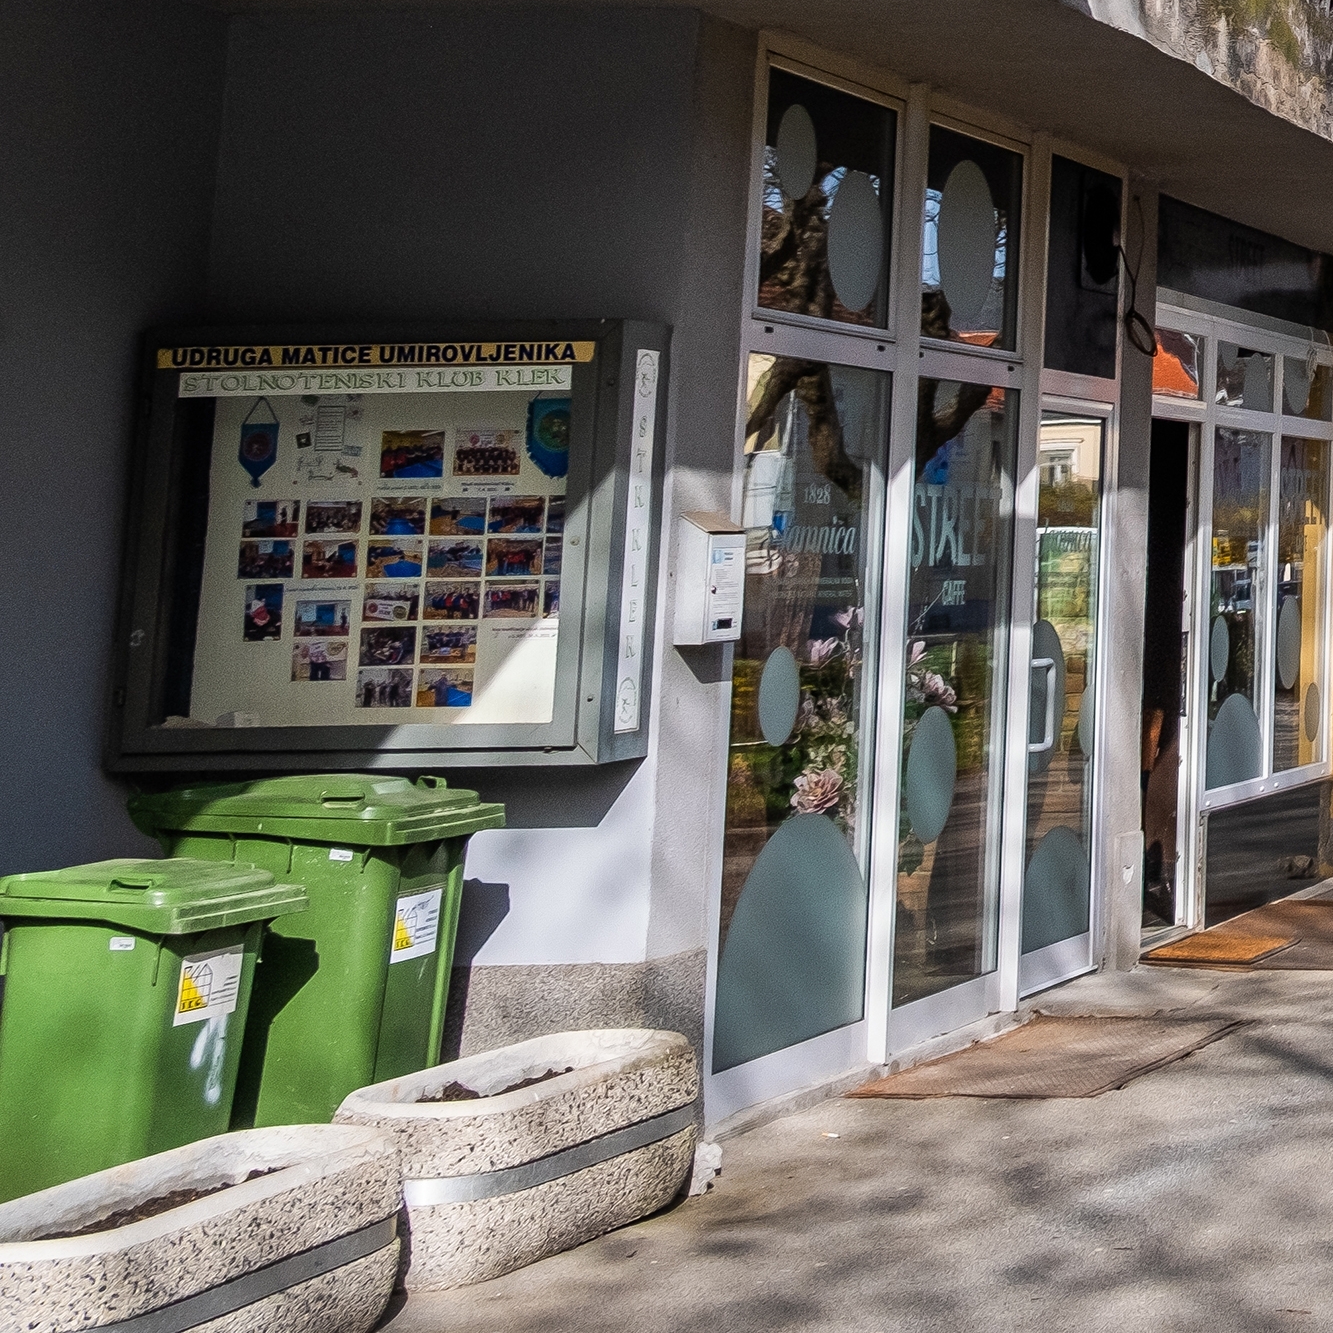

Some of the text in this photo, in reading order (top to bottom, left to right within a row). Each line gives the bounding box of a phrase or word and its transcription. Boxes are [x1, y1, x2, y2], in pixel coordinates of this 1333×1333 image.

[172, 343, 577, 367] UDRUGA MATICE UMIROVLJENIKA
[183, 368, 566, 392] STOLNOTENISKI KLUB KLEK
